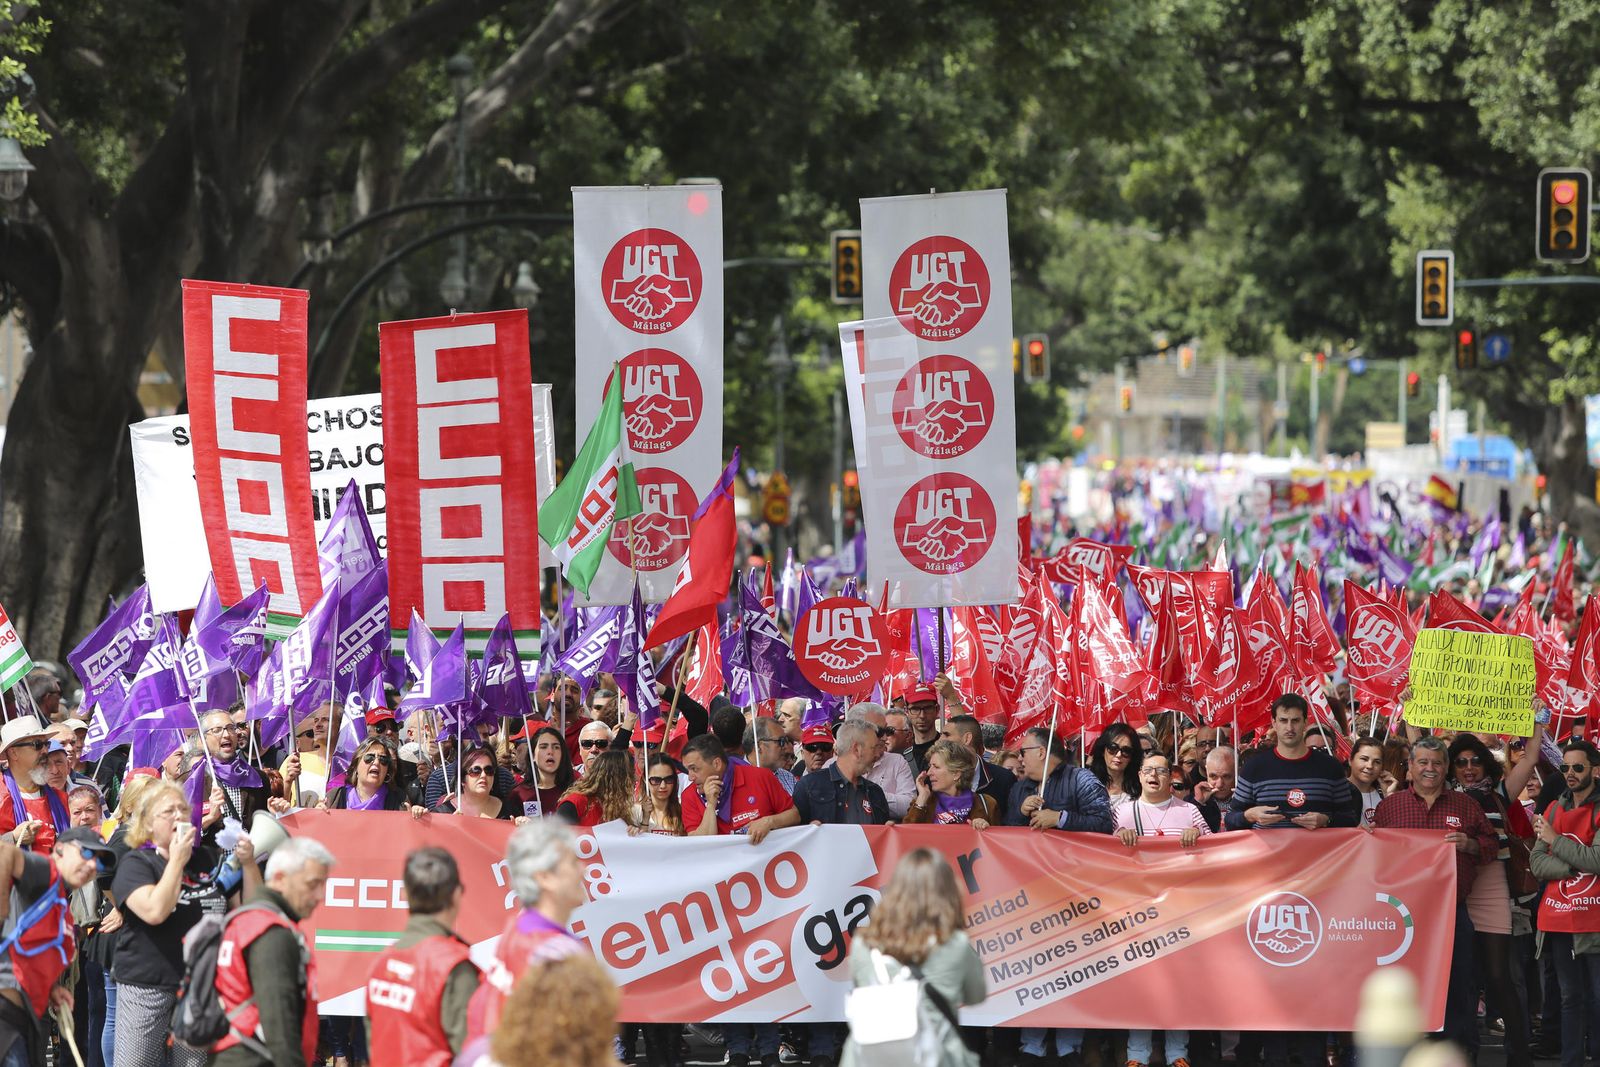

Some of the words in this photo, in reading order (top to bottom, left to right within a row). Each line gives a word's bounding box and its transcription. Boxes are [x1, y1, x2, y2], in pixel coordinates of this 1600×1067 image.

[622, 244, 679, 280] UGT
[910, 251, 967, 290] UGT
[633, 320, 673, 331] Málaga
[921, 326, 961, 338] Málaga
[623, 364, 680, 402] UGT
[913, 370, 971, 408] UGT
[633, 439, 673, 450] Málaga
[924, 445, 964, 455] Málaga
[413, 323, 507, 629] CCOO
[916, 487, 973, 523] UGT
[925, 560, 965, 571] Málaga
[807, 606, 874, 646] UGT
[1351, 610, 1404, 658] UGT
[1510, 662, 1536, 683] MAS
[1029, 895, 1102, 936] empleo
[1257, 904, 1313, 931] UGT
[990, 939, 1078, 984] Mayores
[1081, 905, 1159, 947] salarios
[700, 940, 785, 1002] de
[1015, 956, 1120, 1006] Pensiones
[1123, 926, 1191, 963] dignas
